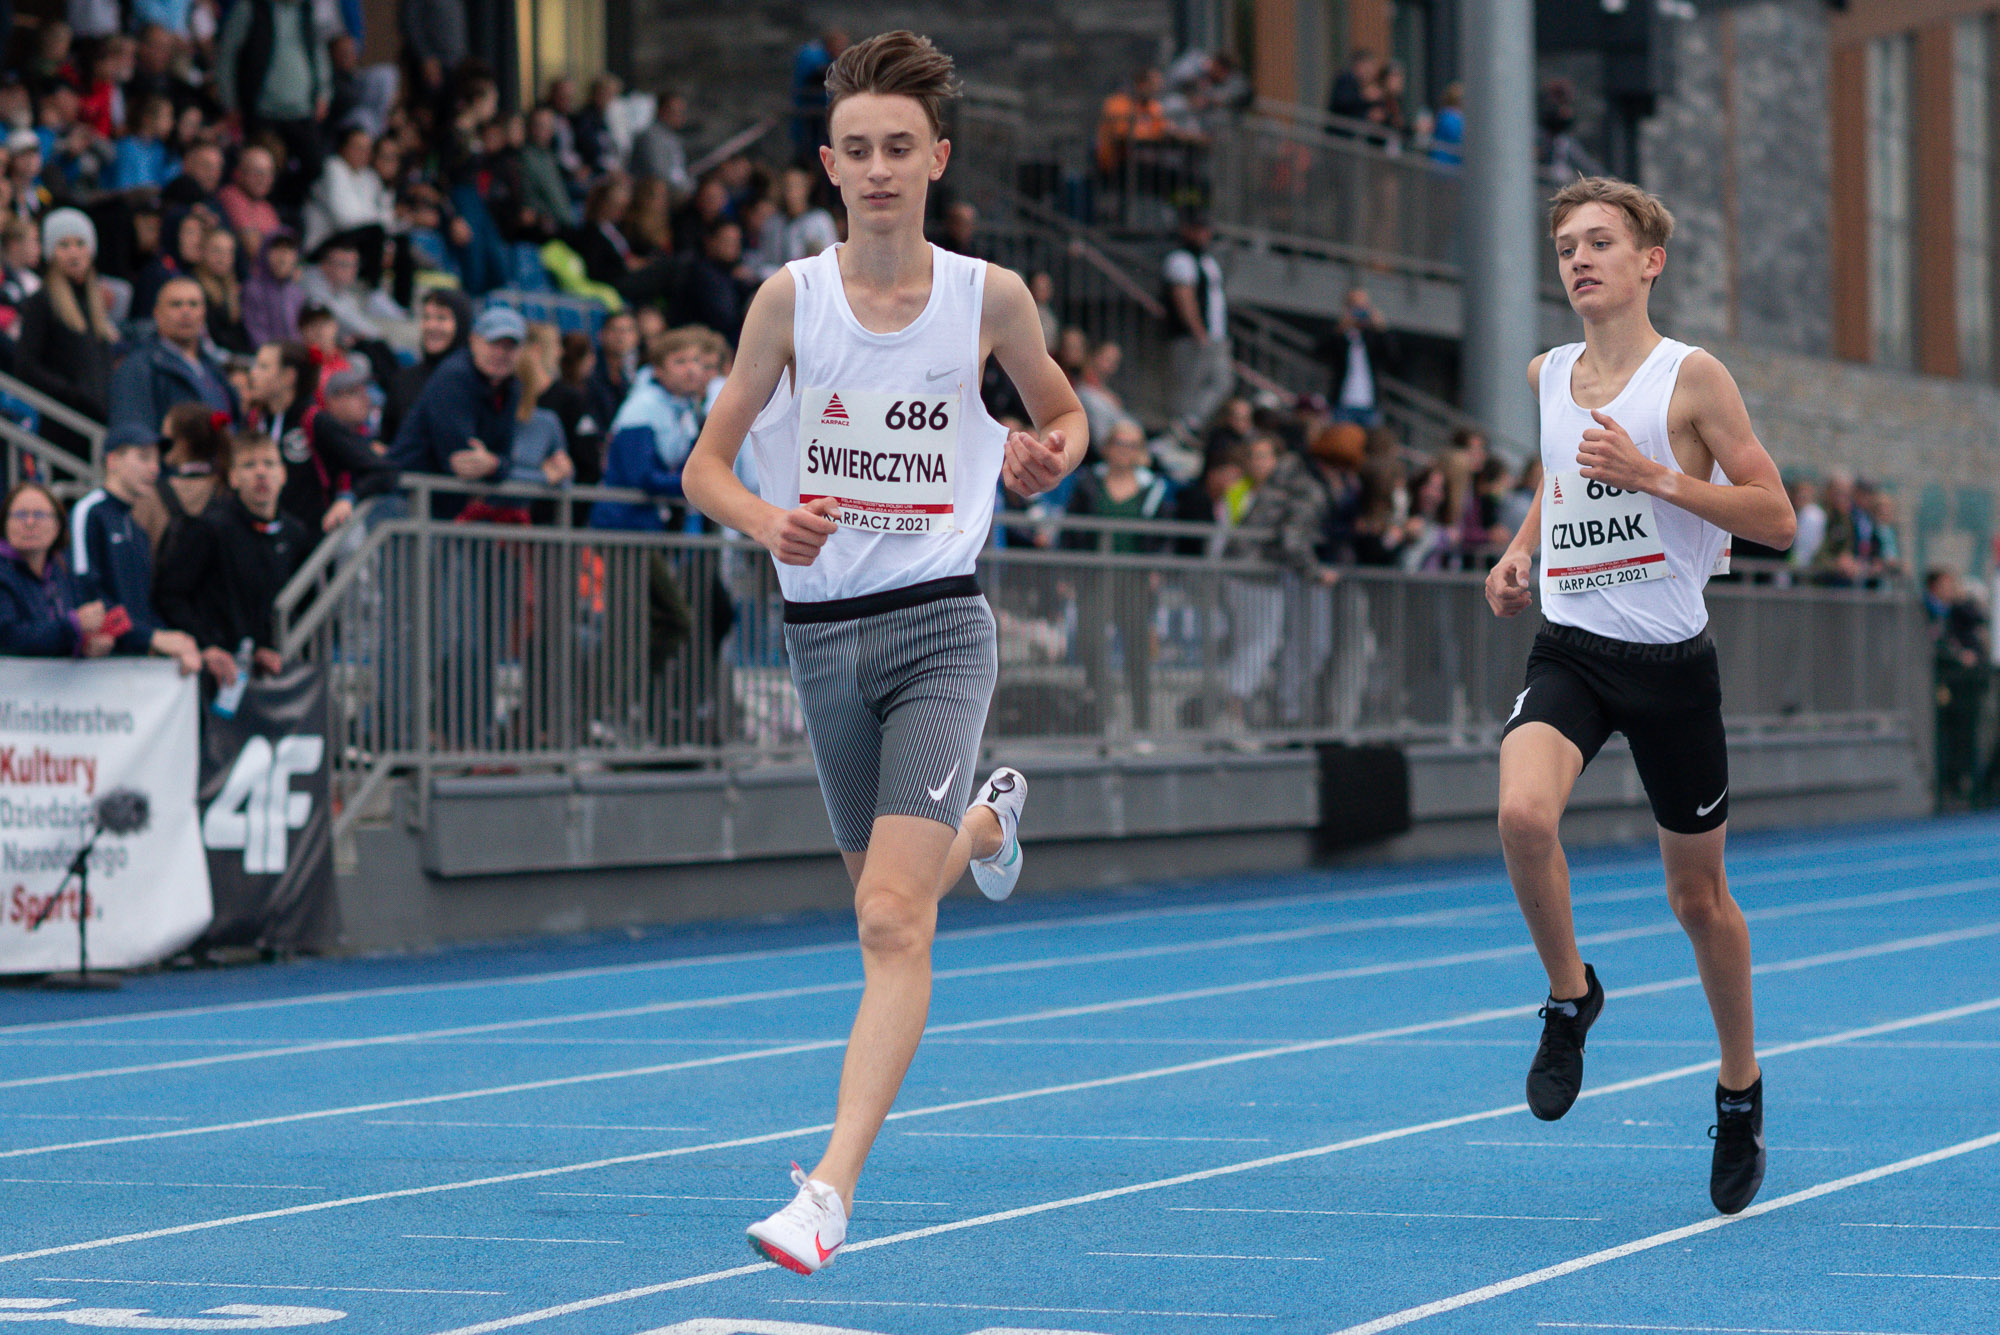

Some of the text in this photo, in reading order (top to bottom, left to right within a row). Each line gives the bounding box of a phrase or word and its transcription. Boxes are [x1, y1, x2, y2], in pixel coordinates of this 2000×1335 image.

[821, 419, 850, 427] KARPACZ
[885, 401, 949, 430] 686
[807, 438, 947, 483] ŚWIERCZYNA
[895, 517, 930, 531] 2021
[1551, 512, 1648, 550] CZUBAK
[1558, 573, 1615, 592] KARPACZ
[1616, 567, 1648, 583] 2021
[0, 746, 97, 793] Kultury
[203, 735, 324, 874] 4F
